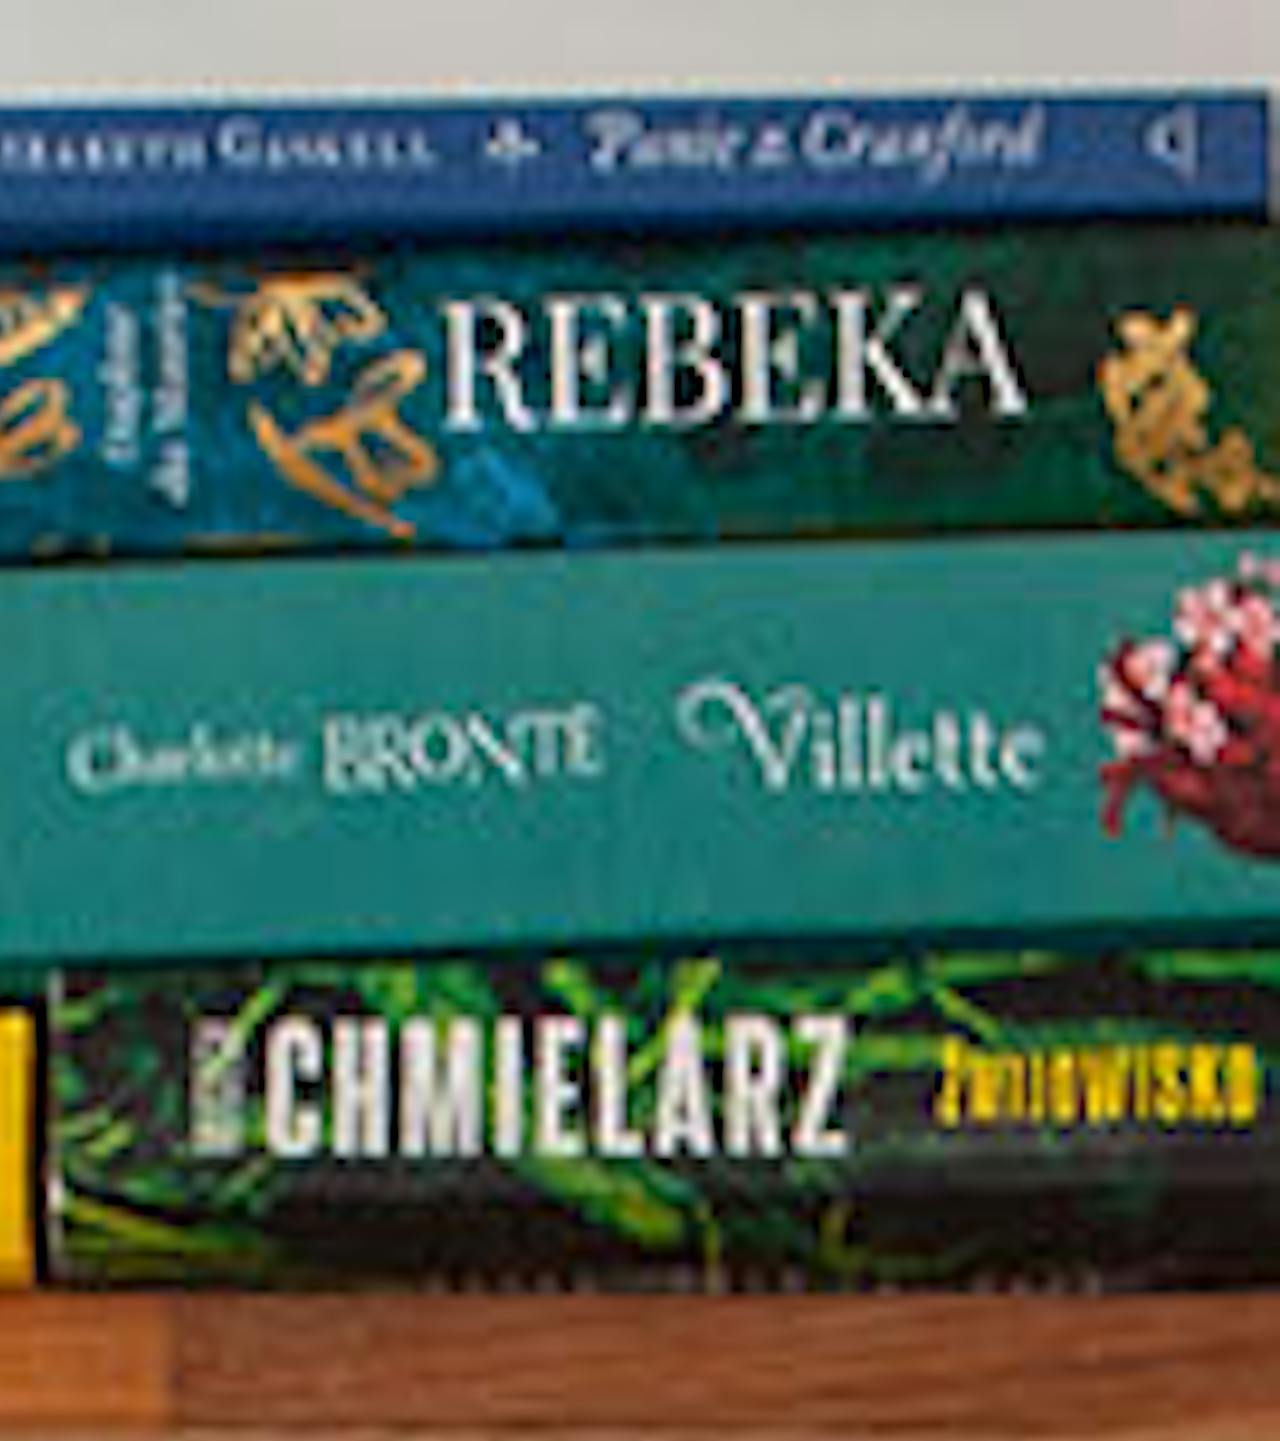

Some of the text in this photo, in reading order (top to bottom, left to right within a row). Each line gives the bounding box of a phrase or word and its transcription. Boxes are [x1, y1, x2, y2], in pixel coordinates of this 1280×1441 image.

[440, 283, 1030, 432] REBEKA
[67, 719, 296, 794] Charlotte
[677, 679, 1044, 790] Villette
[264, 1014, 851, 1160] CHMIELARZ
